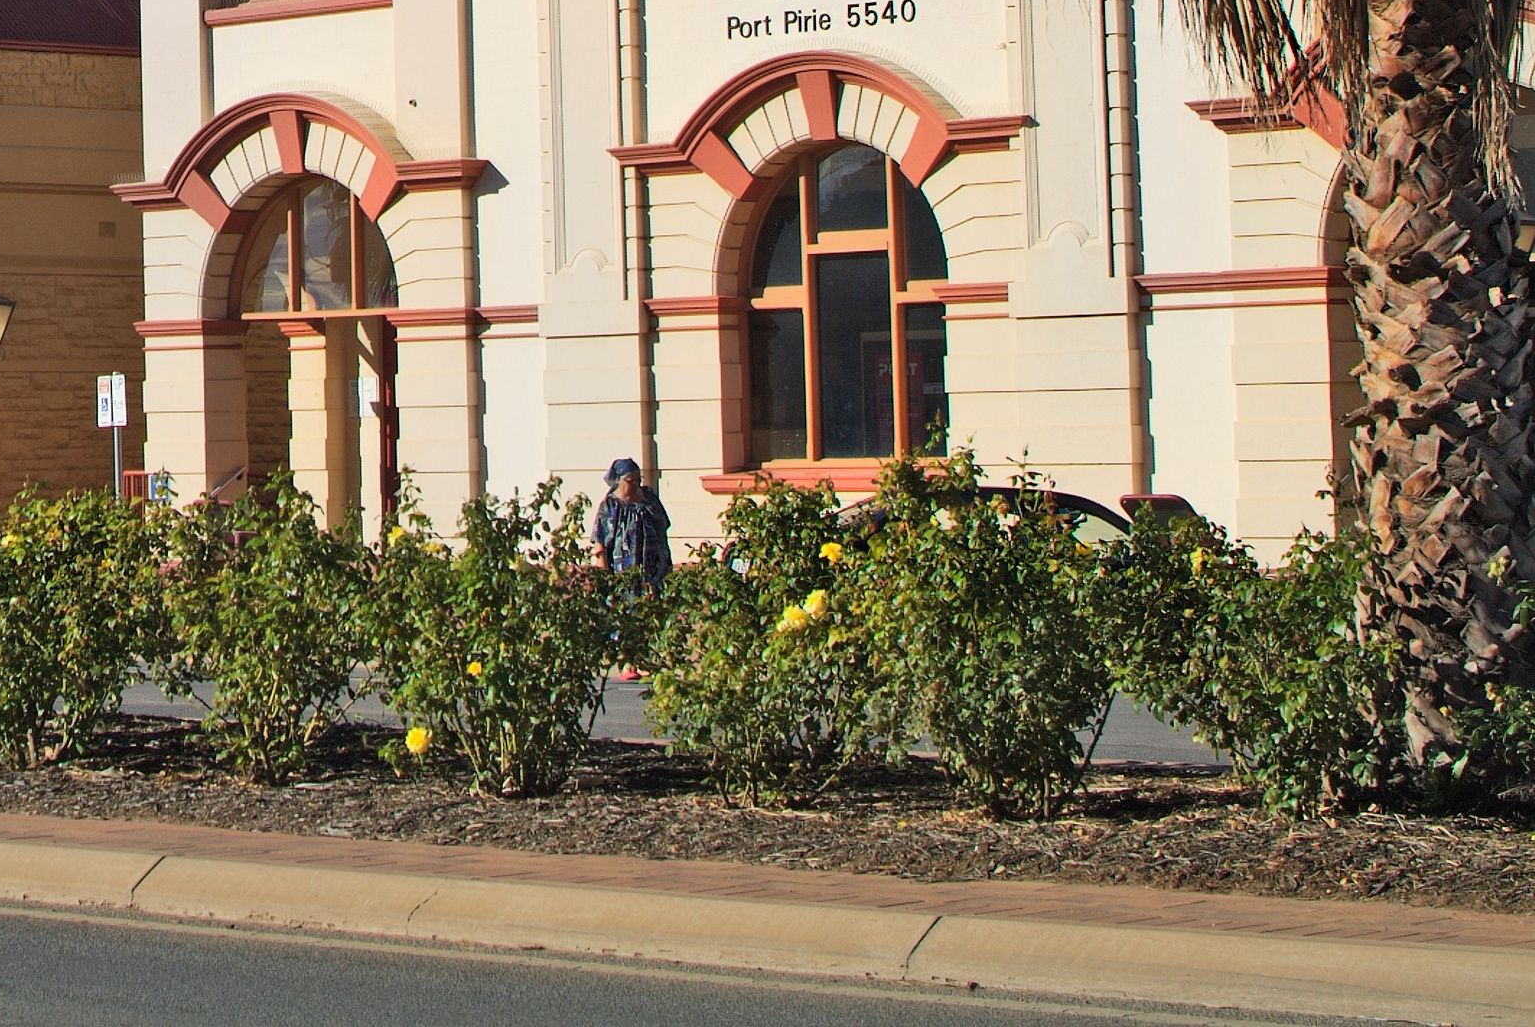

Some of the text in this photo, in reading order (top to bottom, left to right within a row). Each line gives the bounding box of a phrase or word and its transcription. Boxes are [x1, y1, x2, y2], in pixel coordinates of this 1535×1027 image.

[726, 15, 772, 40] Port
[783, 9, 832, 35] Pirie
[878, 362, 918, 377] PT
